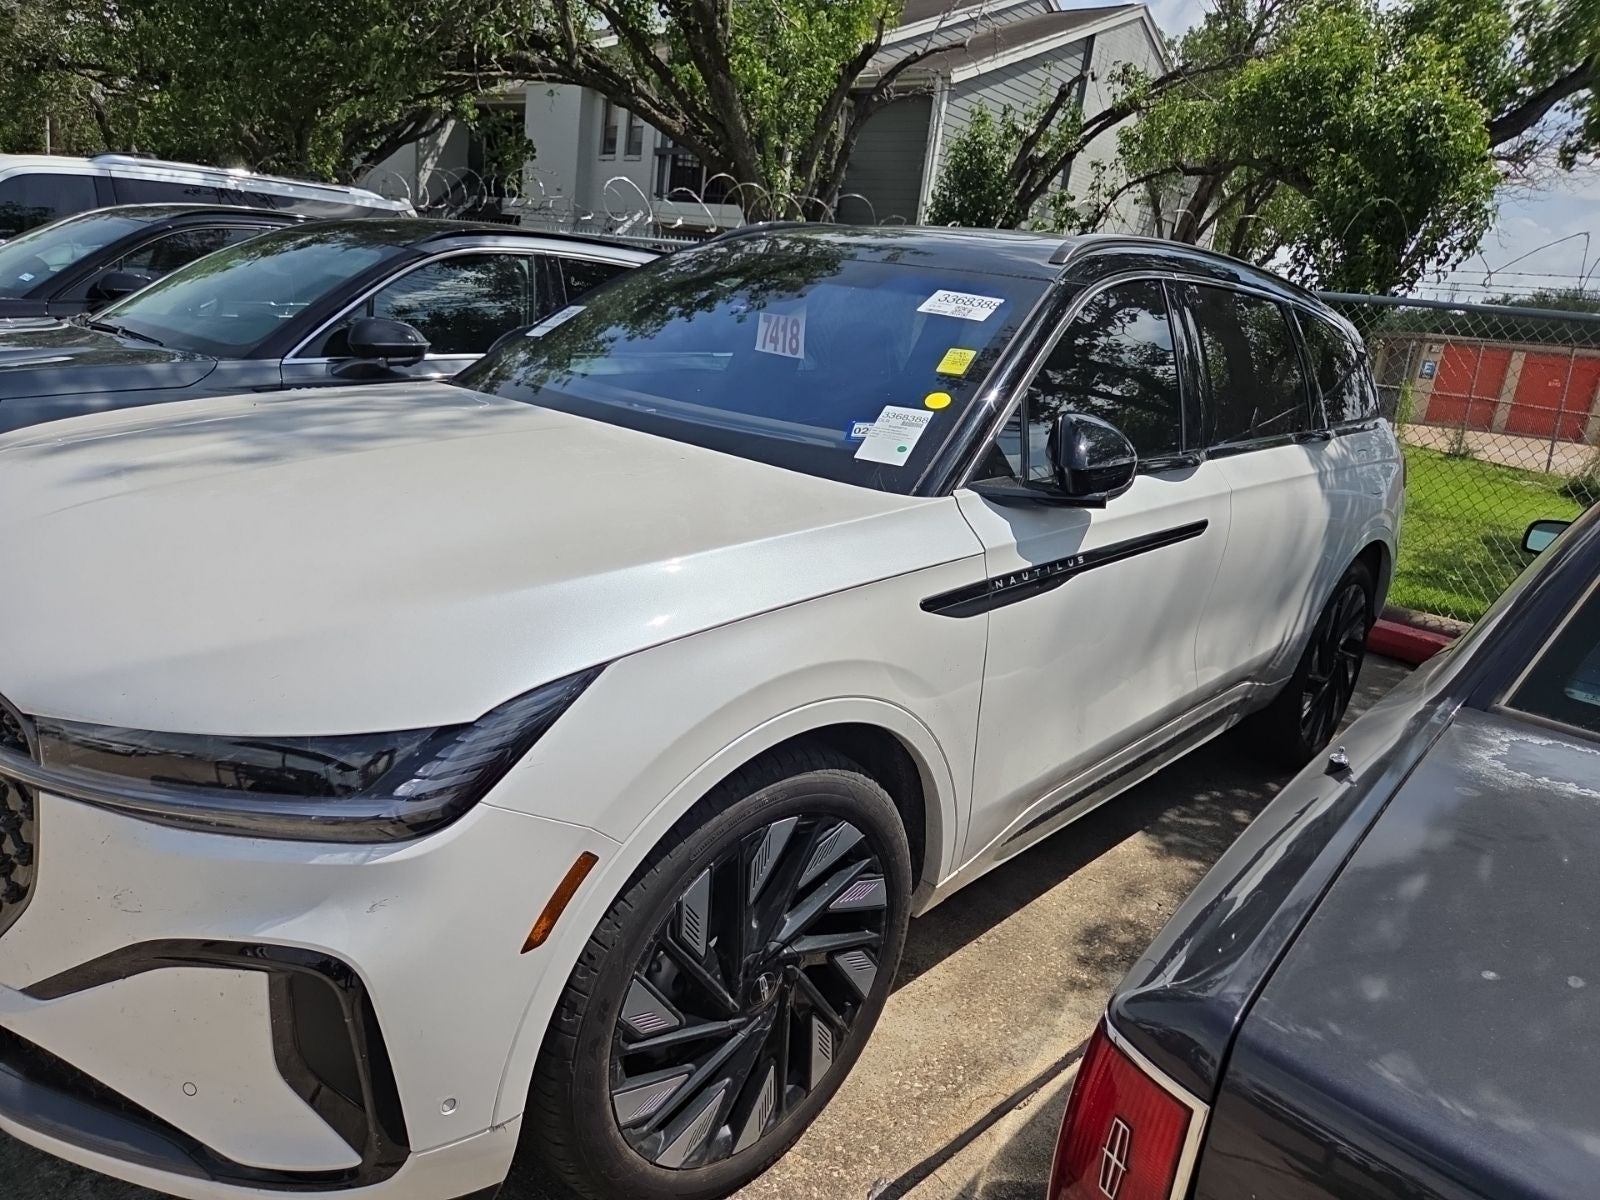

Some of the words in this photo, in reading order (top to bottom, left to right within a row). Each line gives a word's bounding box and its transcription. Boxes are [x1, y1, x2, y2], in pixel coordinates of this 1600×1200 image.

[762, 314, 801, 355] 7418
[882, 411, 929, 424] 3368388
[853, 427, 869, 435] 02
[995, 556, 1085, 590] NAUTILUS
